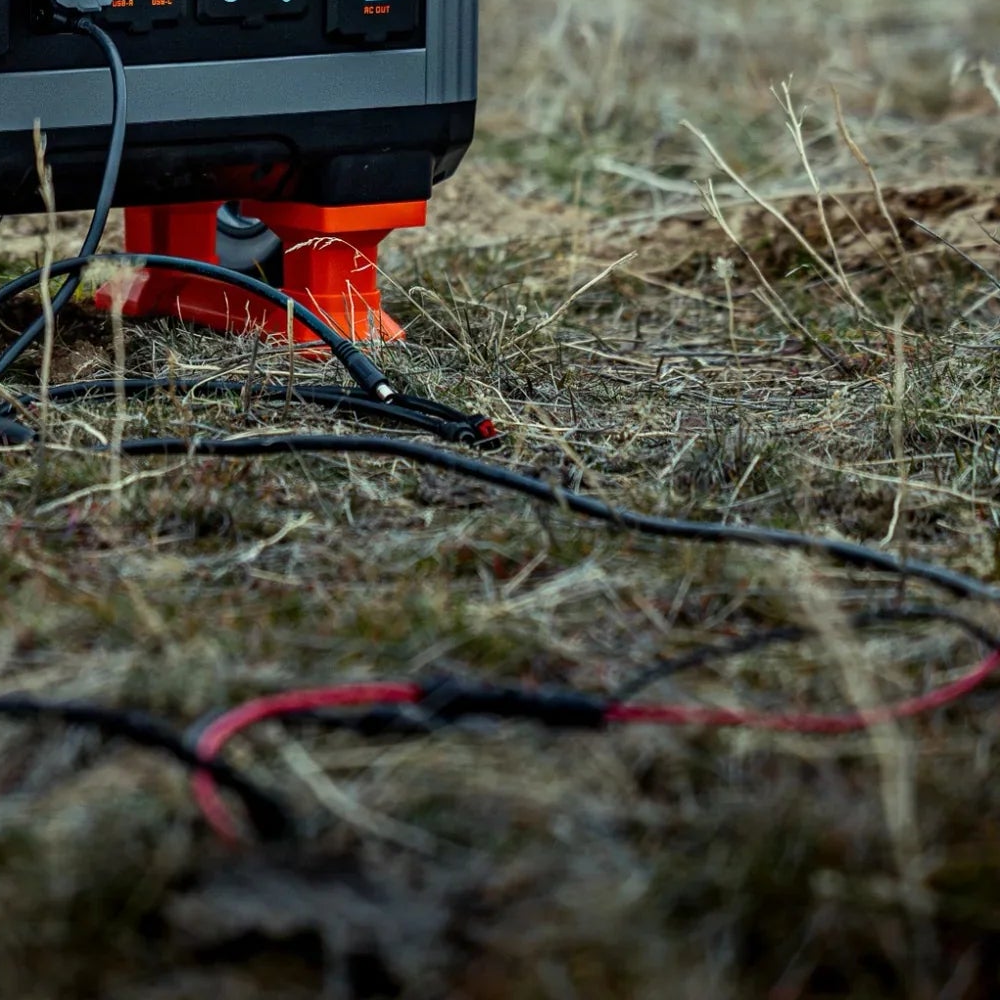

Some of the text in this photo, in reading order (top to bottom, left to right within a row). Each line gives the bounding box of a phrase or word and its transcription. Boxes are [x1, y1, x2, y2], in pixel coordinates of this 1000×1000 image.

[112, 0, 134, 8] USB-A
[363, 4, 391, 15] AC OUT
